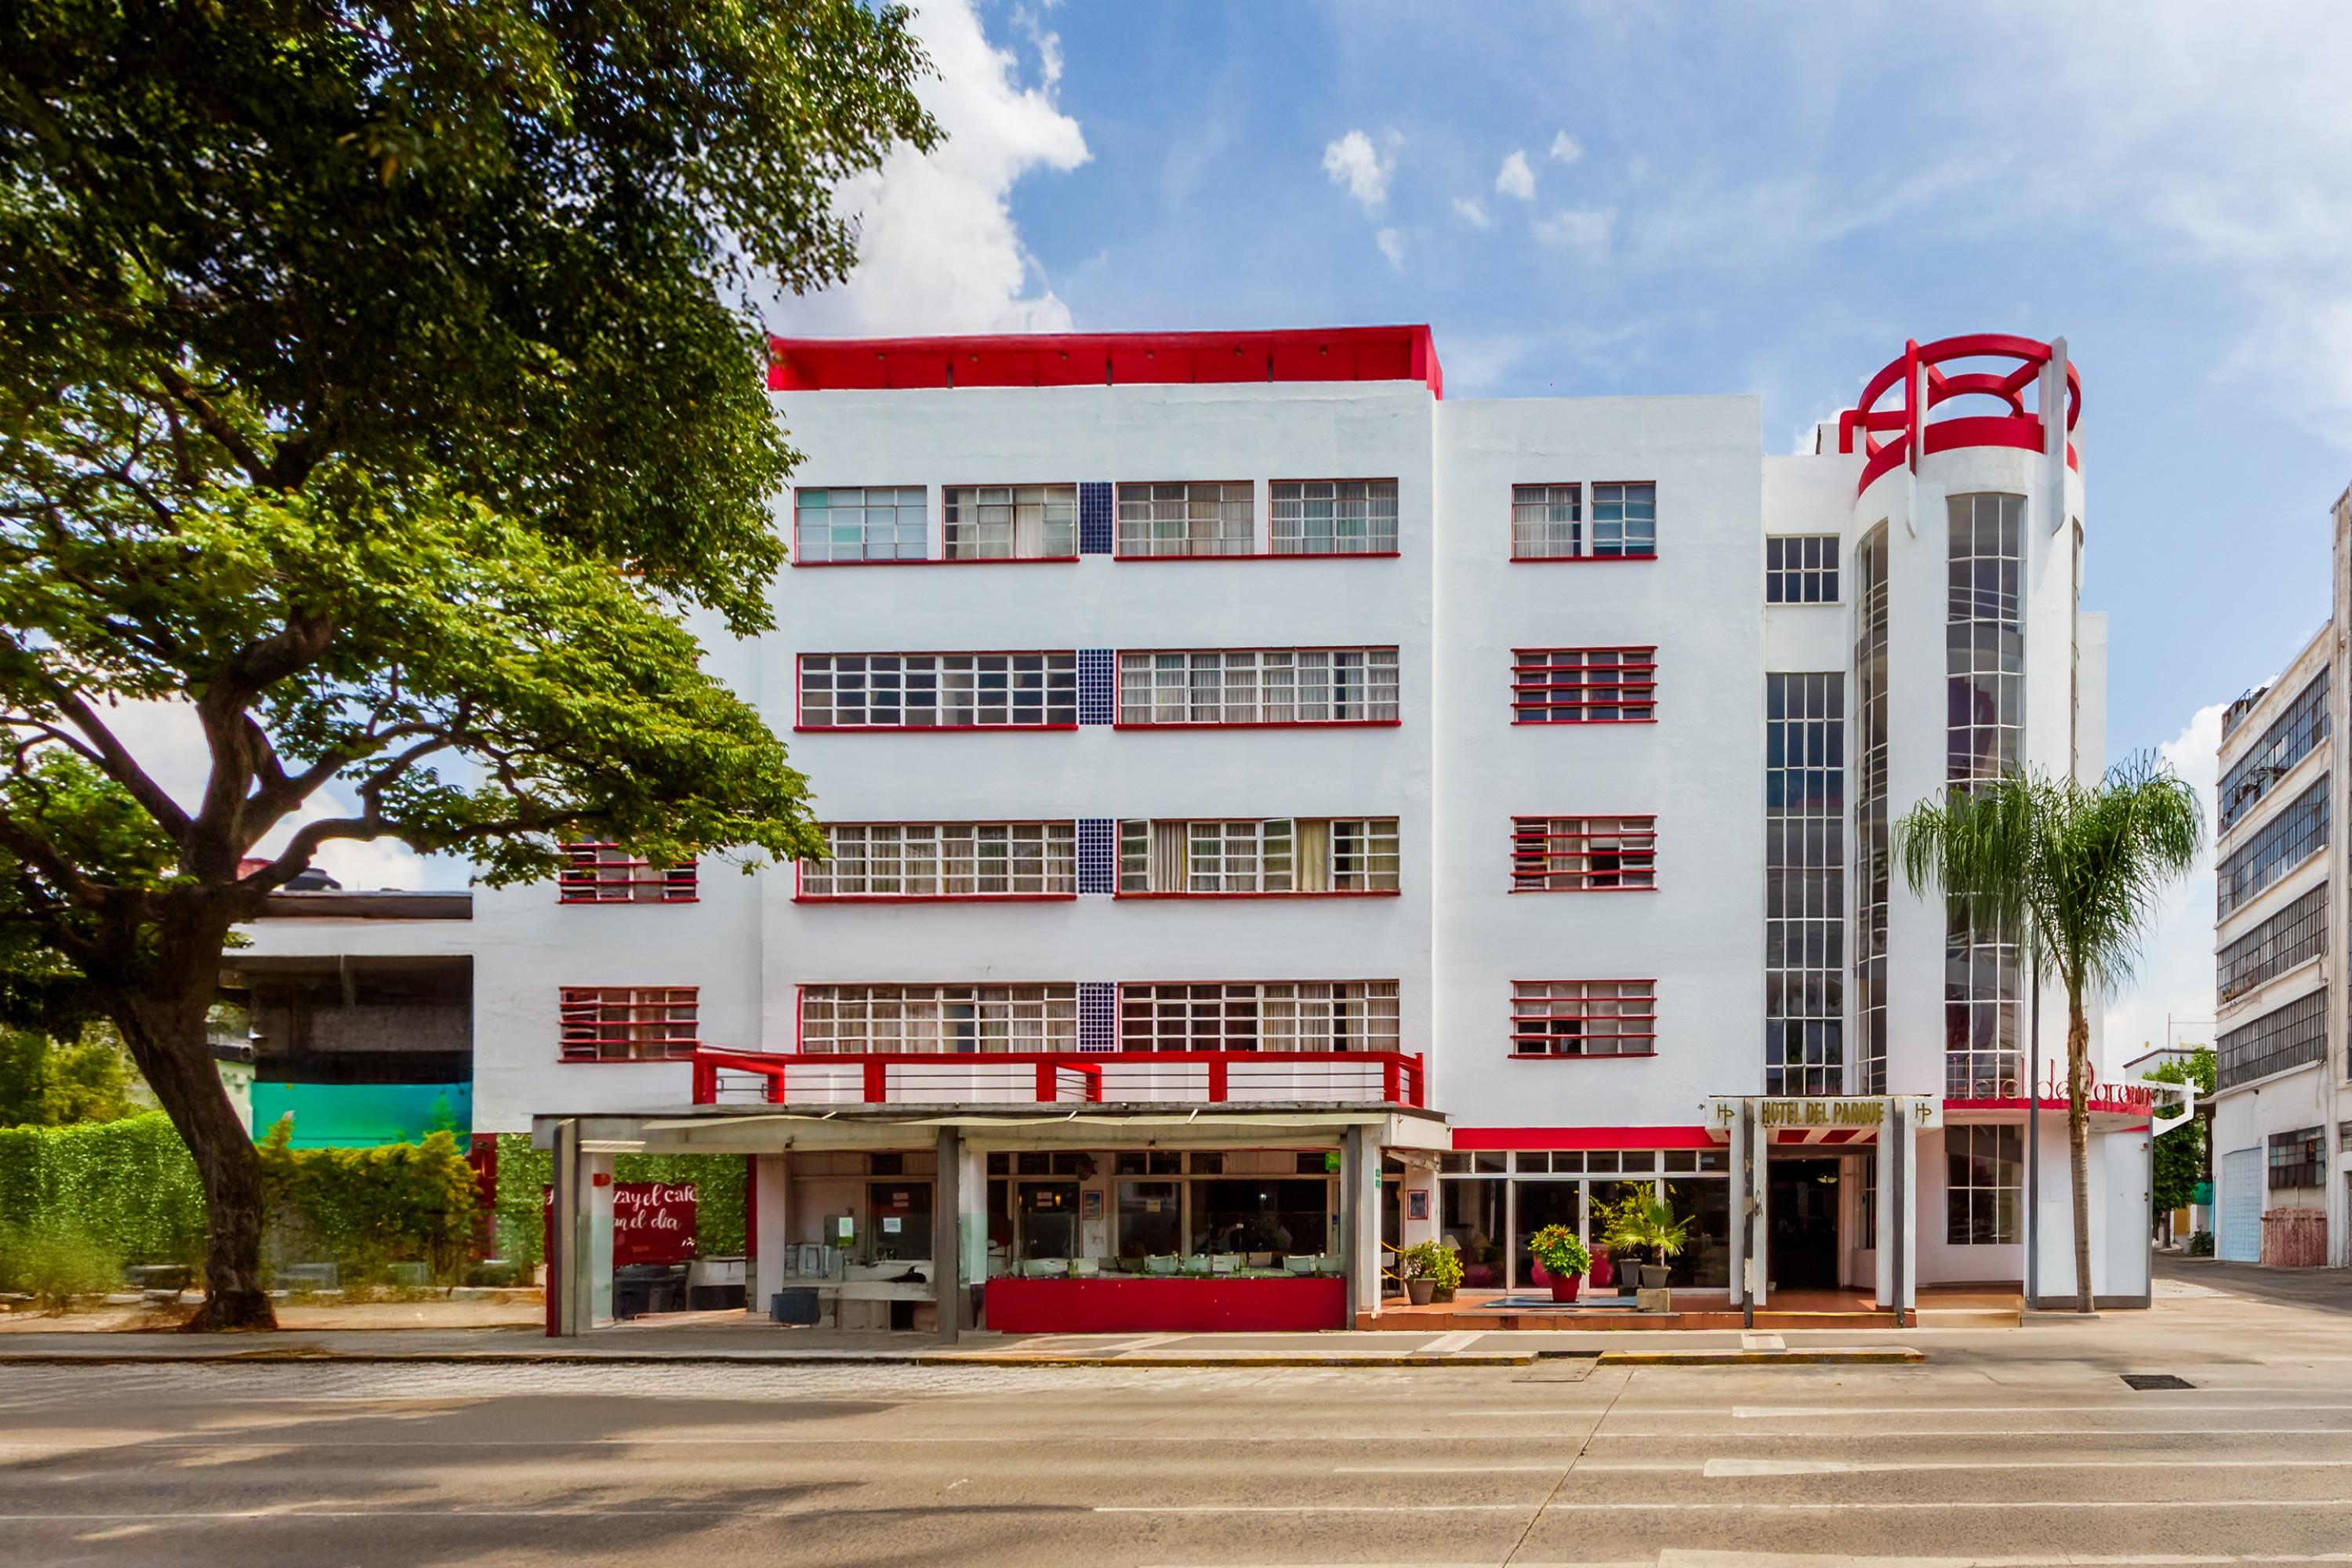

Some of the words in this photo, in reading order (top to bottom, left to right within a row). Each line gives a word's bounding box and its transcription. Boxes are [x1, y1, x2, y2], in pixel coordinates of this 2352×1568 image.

[1762, 1101, 1802, 1124] HOTEL
[1806, 1102, 1829, 1124] DEL
[1834, 1102, 1884, 1124] PARQUE
[643, 1184, 663, 1207] el
